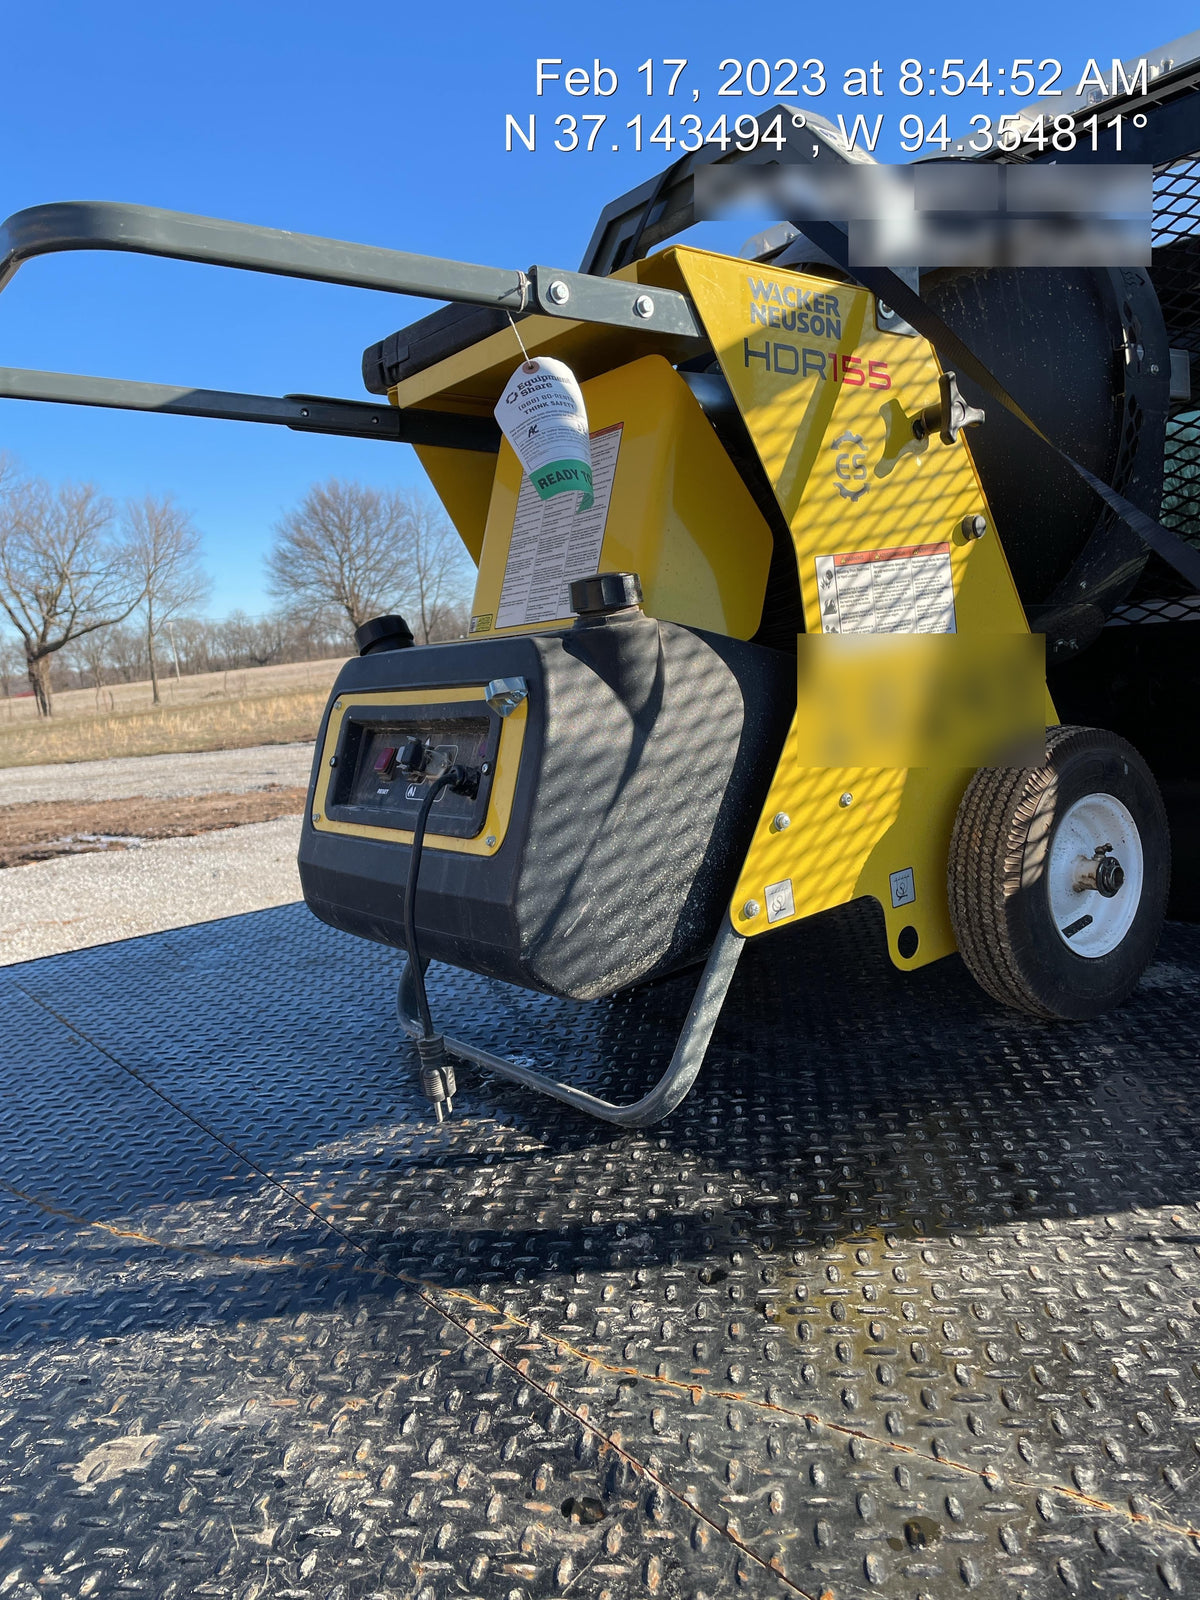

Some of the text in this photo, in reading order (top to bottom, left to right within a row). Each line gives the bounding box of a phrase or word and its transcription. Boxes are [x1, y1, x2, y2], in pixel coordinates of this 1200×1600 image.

[747, 277, 841, 318] WACKER
[750, 302, 842, 341] NEUSON
[520, 382, 553, 397] Share
[524, 400, 575, 415] THINK SAFETY
[835, 453, 868, 480] ES
[537, 469, 579, 490] READY
